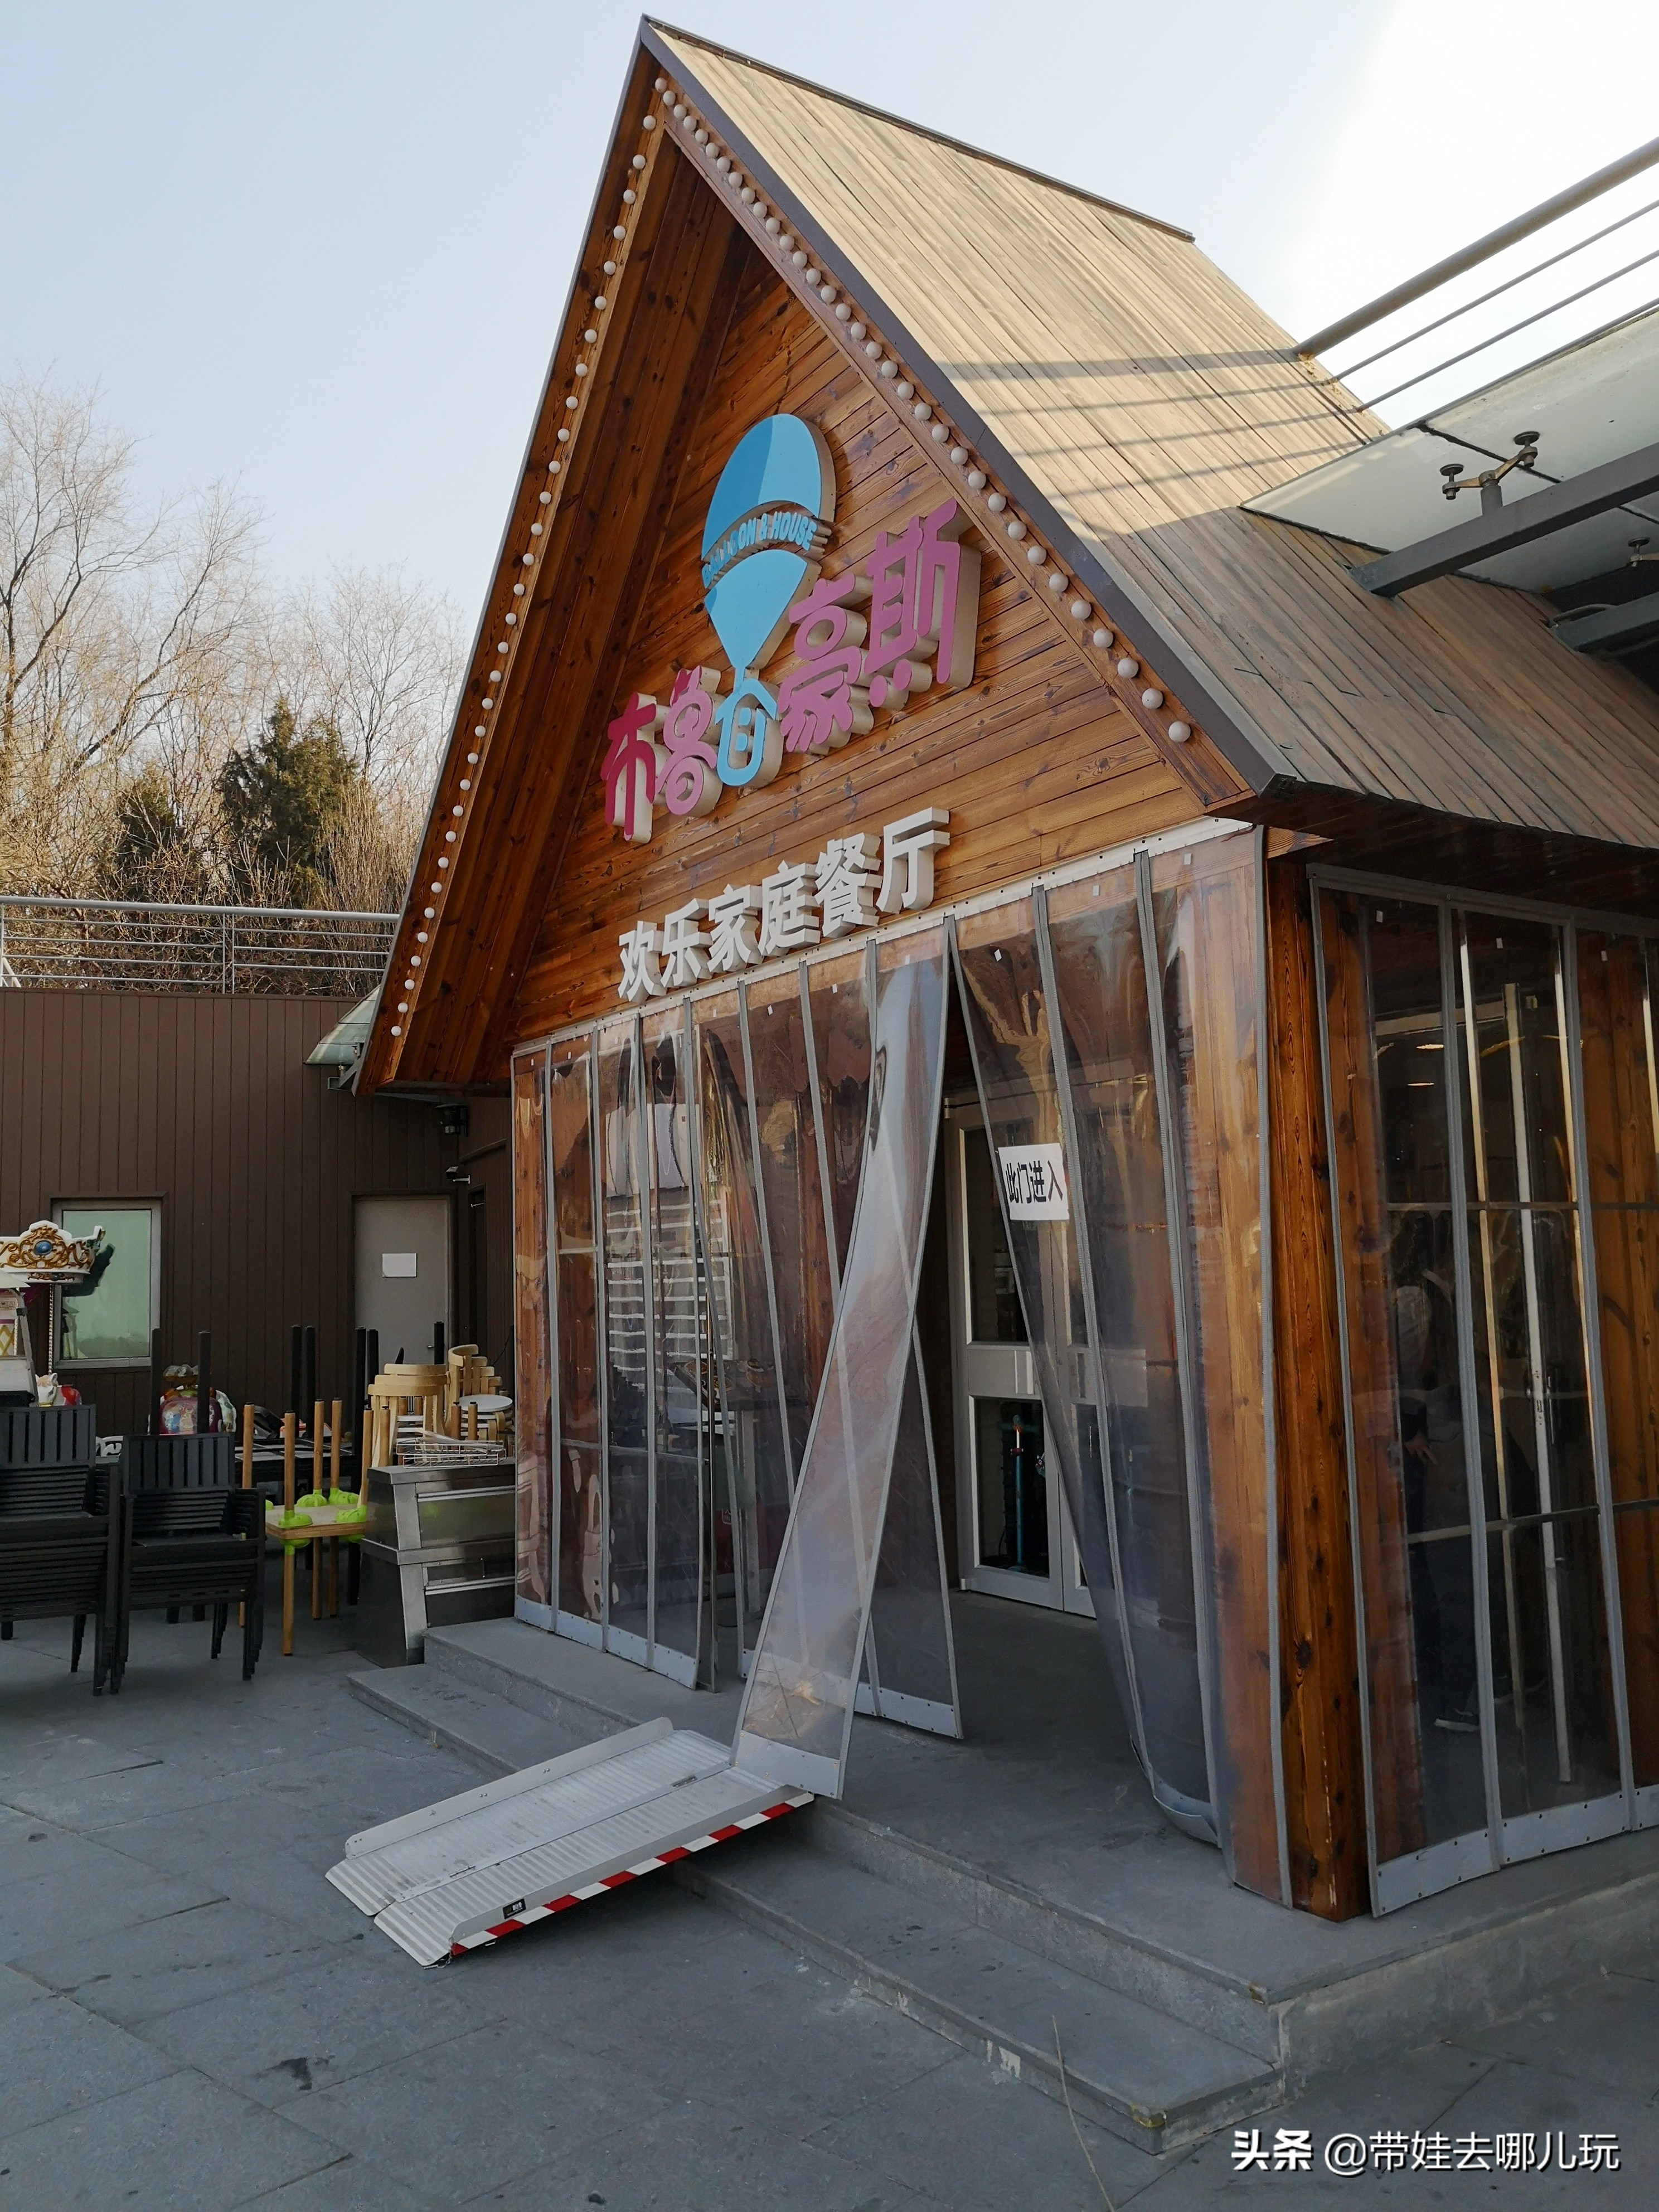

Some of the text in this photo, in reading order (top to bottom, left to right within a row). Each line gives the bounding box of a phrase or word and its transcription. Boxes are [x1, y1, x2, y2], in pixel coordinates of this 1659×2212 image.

[701, 511, 818, 589] BALLOON & HOUSE
[618, 807, 950, 1003] 欢乐家庭餐厅
[1005, 1160, 1064, 1204] 此门进入
